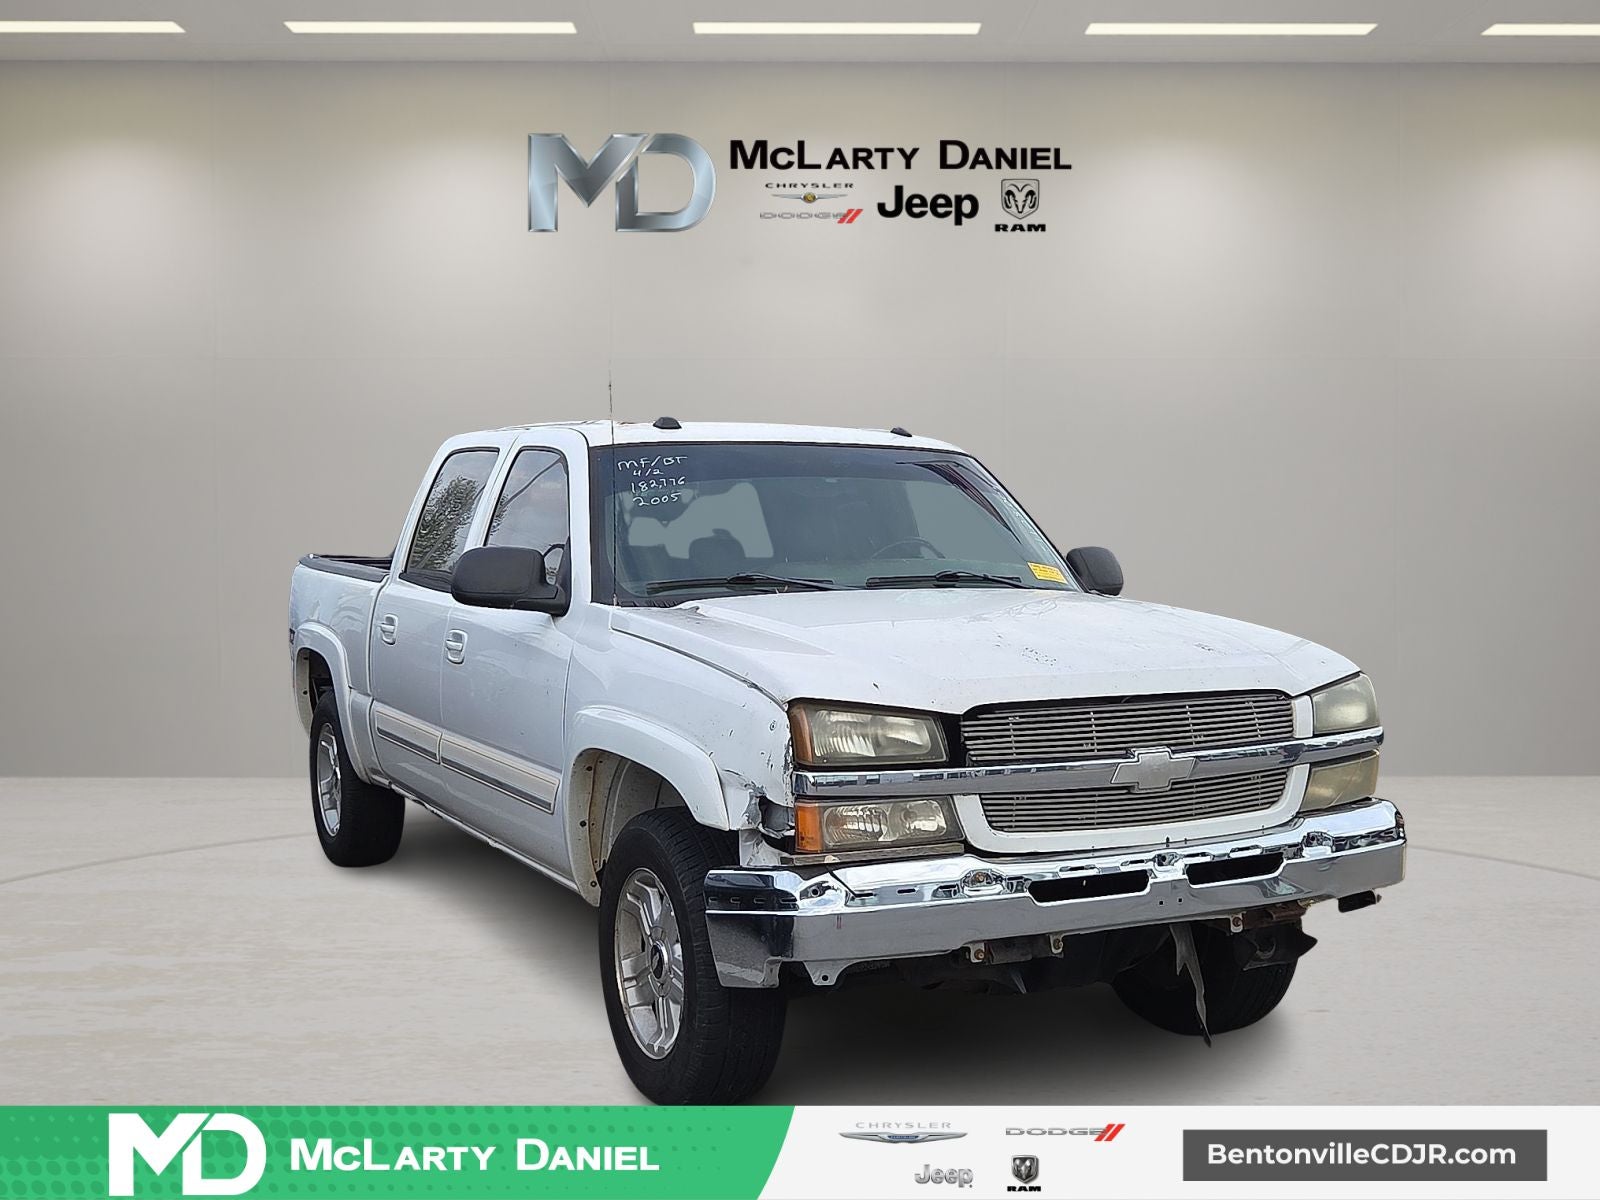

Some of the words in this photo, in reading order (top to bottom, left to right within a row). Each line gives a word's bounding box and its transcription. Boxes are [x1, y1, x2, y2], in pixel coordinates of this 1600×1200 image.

[939, 139, 1072, 170] DANIEL
[877, 184, 980, 226] Jeep
[759, 211, 848, 220] DODGE
[994, 223, 1047, 232] RAM
[632, 492, 682, 507] 2005
